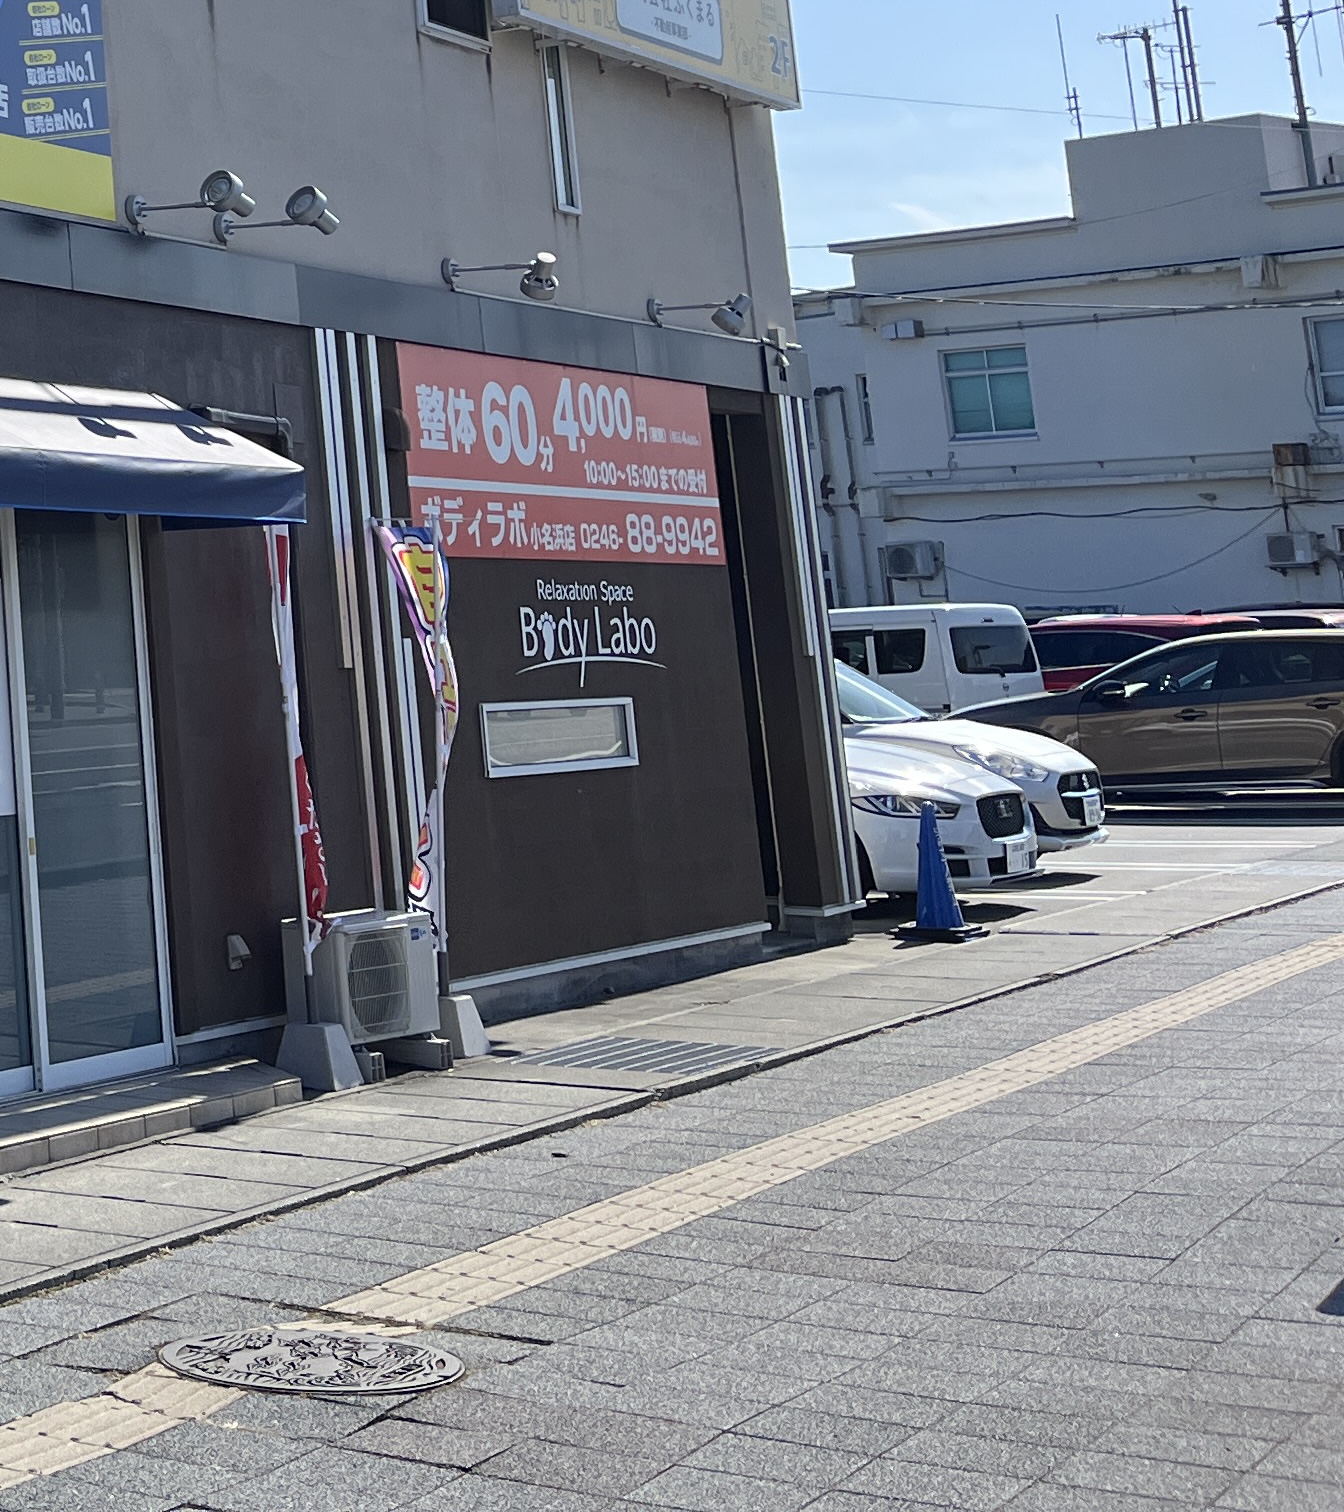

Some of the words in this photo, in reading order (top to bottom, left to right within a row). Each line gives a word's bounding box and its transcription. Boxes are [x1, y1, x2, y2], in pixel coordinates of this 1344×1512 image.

[536, 579, 598, 601] Relaxation
[600, 580, 634, 605] Space
[595, 606, 656, 655] Labo
